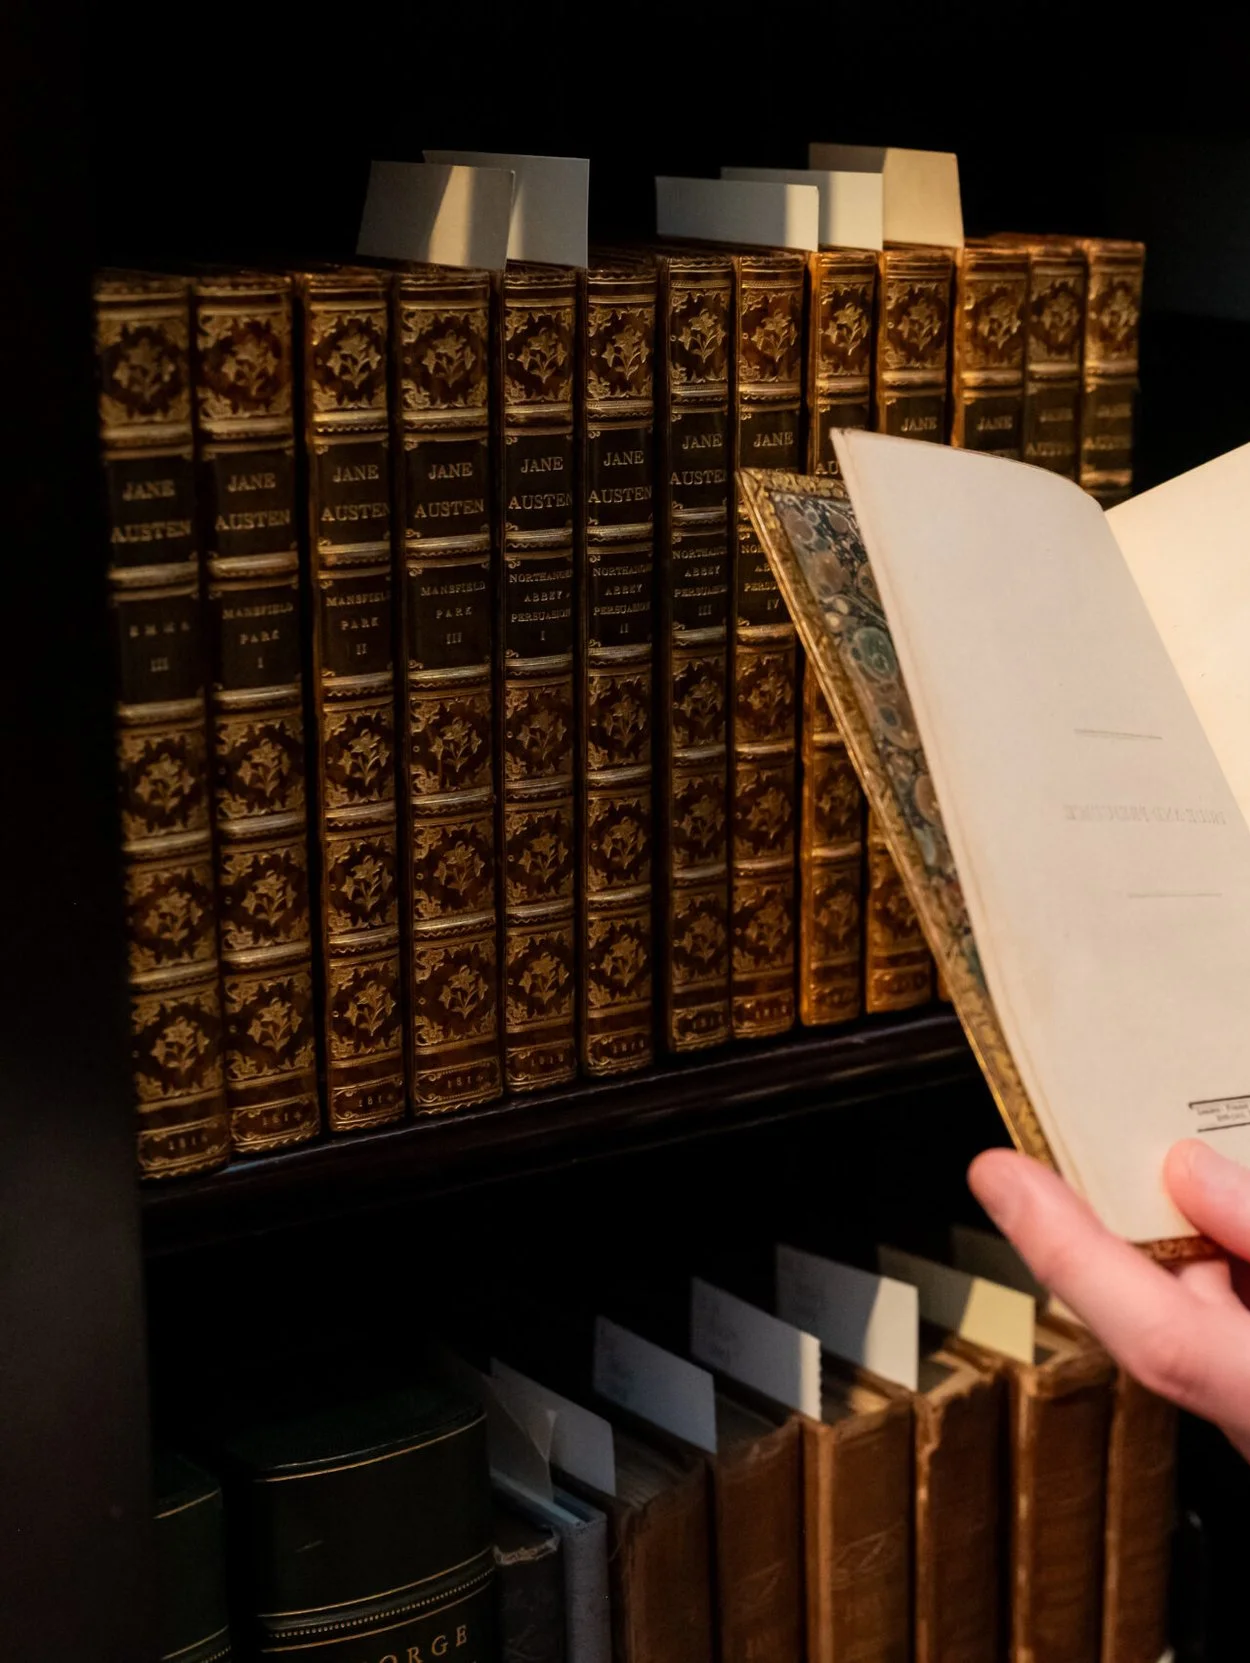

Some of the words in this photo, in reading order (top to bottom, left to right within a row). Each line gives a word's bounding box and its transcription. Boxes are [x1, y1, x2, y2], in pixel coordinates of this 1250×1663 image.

[901, 416, 938, 432] JANE
[976, 415, 1013, 431] JANE
[681, 432, 723, 450] JANE
[752, 431, 794, 448] JANE
[520, 456, 564, 473] JANE
[603, 449, 645, 467] JANE
[331, 464, 380, 483] JANE
[427, 462, 474, 480] JANE
[122, 479, 176, 501] JANE
[226, 472, 276, 493] JANE
[508, 491, 573, 510] AUSTEN
[587, 485, 653, 504] AUSTEN
[320, 502, 390, 522] AUSTEN
[414, 498, 485, 519] AUSTEN
[214, 508, 291, 531] AUSTEN
[110, 519, 192, 544] AUSTEN
[684, 565, 721, 578] ABBEY
[420, 580, 486, 597] MANSFIELD
[523, 590, 563, 603] ABBEY
[603, 583, 643, 596] ABBEY
[435, 606, 472, 620] PARK
[698, 604, 712, 617] III
[340, 616, 380, 631] PARK
[619, 622, 629, 634] II
[239, 629, 281, 645] PARK
[445, 632, 462, 645] III
[539, 630, 546, 641] I
[356, 643, 368, 655] II
